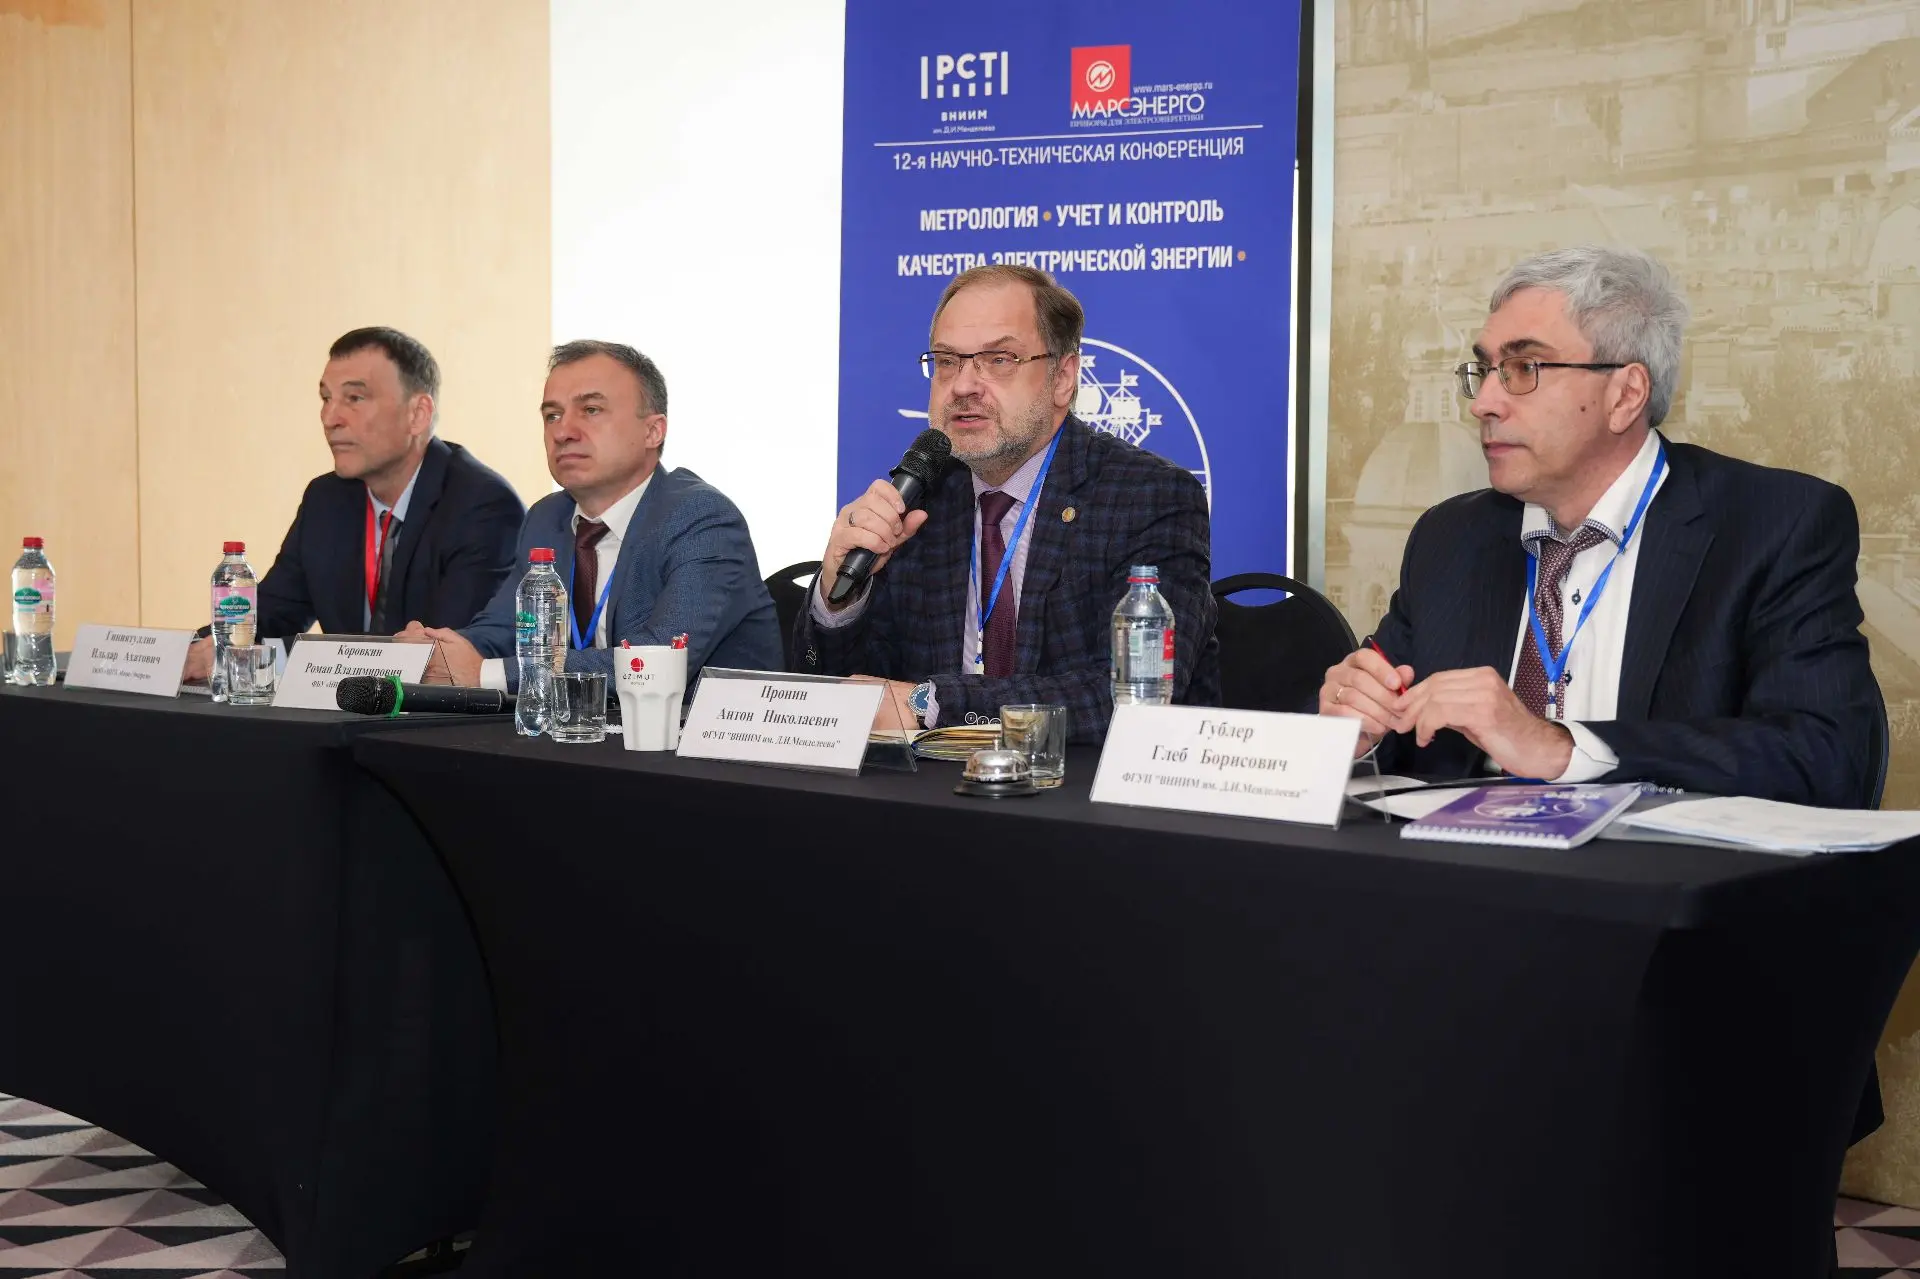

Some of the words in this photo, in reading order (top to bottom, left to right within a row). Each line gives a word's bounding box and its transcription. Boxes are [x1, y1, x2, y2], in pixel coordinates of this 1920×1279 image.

[936, 51, 998, 81] РСТ
[1133, 82, 1213, 94] www.mars-energo.ru
[941, 110, 988, 122] ВНИИМ
[1072, 93, 1205, 120] МАРСЭНЕРГО
[893, 153, 926, 170] 12-я
[930, 143, 1115, 169] НАУЧНО-ТЕХНИЧЕСКАЯ
[1120, 136, 1244, 161] КОНФЕРЕНЦИЯ
[920, 205, 1038, 231] МЕТРОЛОГИЯ
[1056, 203, 1104, 228] УЧЕТ
[1108, 203, 1121, 226] И
[1126, 199, 1224, 225] КОНТРОЛЬ
[897, 252, 987, 277] КАЧЕСТВА
[1150, 245, 1233, 270] ЭНЕРГИИ
[91, 648, 119, 663] Ильдар
[123, 651, 161, 665] Ахатович
[337, 643, 384, 659] Коровкин
[305, 662, 332, 675] Роман
[333, 663, 403, 678] Владимирович
[760, 684, 808, 703] Пронин
[716, 707, 754, 723] Антон
[762, 709, 839, 728] Николаевич
[702, 730, 726, 740] ФГУП
[762, 736, 775, 745] им.
[1198, 719, 1254, 742] Гублер
[1151, 745, 1188, 763] Глеб
[1200, 748, 1289, 772] Борисович
[1122, 772, 1153, 785] ФГУП
[1201, 781, 1218, 791] им.
